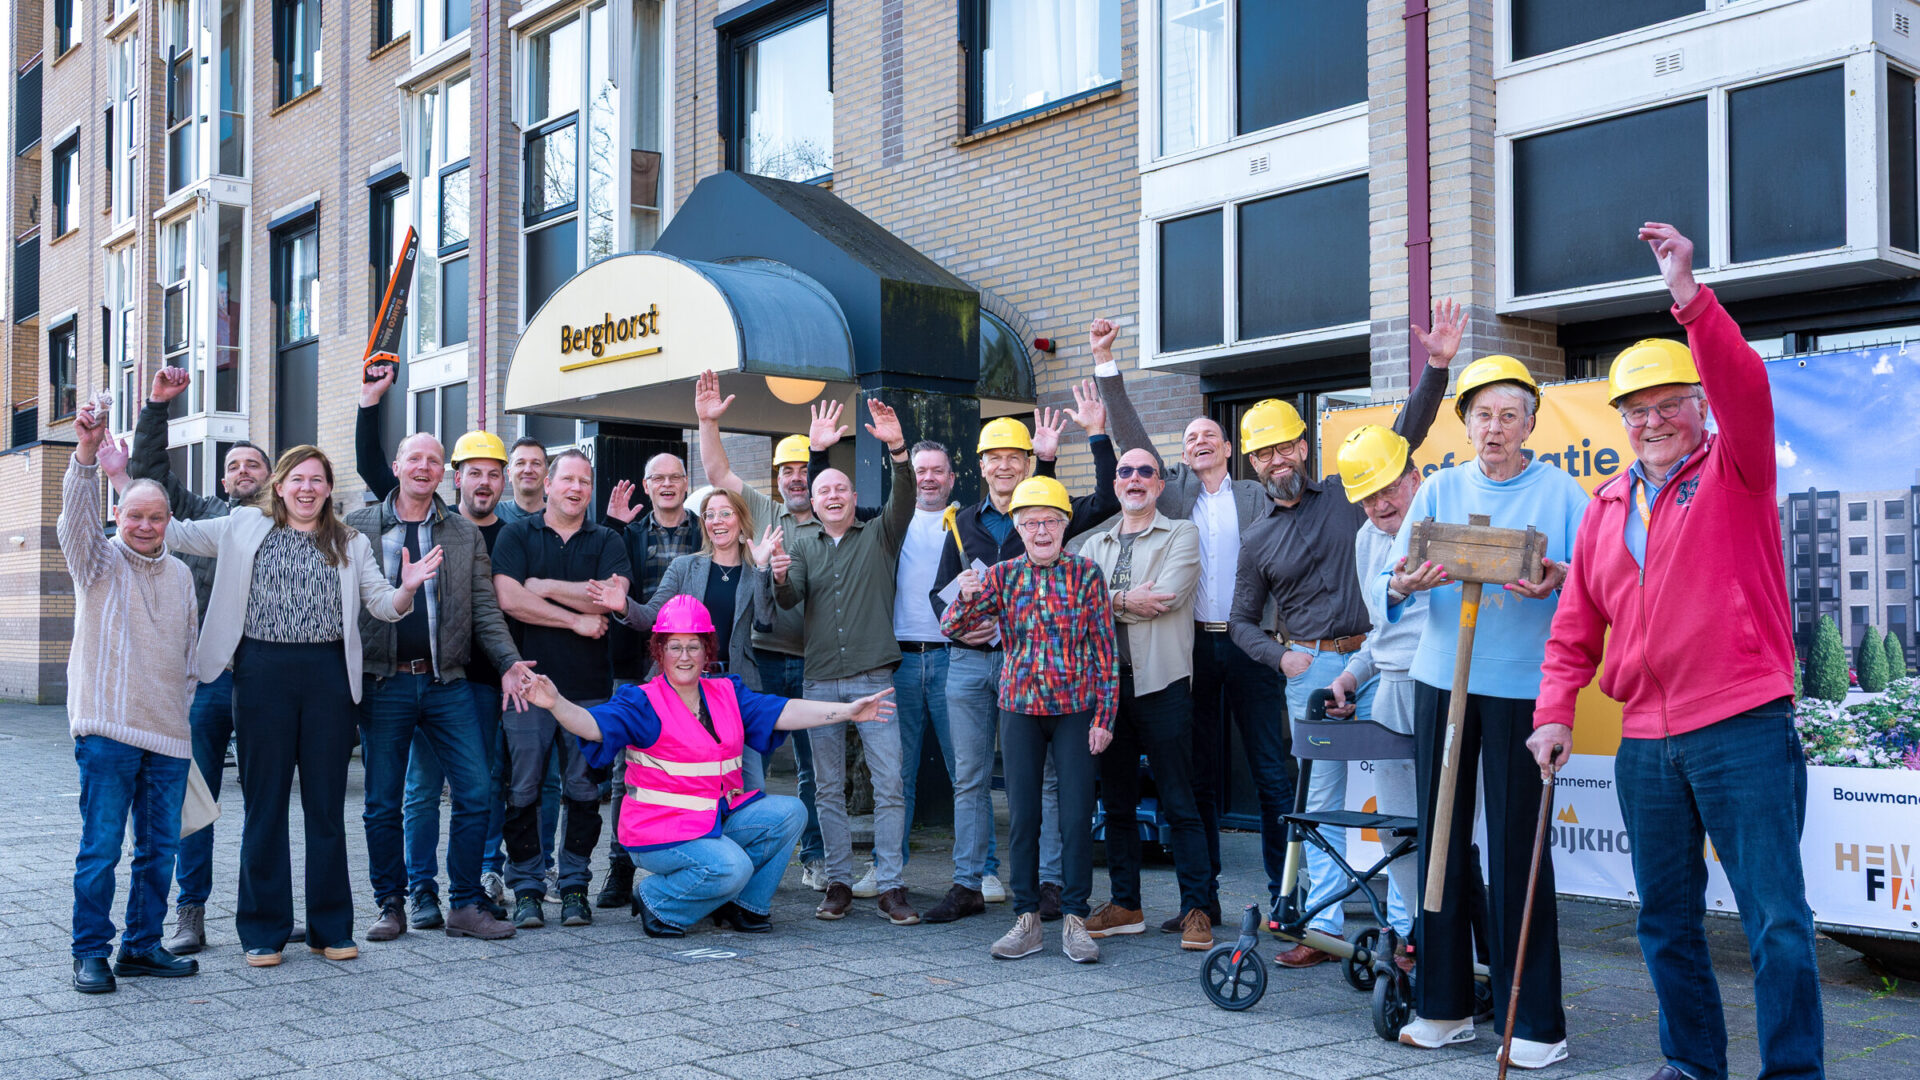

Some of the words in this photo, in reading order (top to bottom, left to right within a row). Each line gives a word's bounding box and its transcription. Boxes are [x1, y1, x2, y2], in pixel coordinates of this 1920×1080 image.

[561, 303, 659, 358] Berghorst
[1553, 776, 1612, 789] annemer
[1833, 787, 1920, 805] Bouwman
[1551, 826, 1632, 854] DIJKHO
